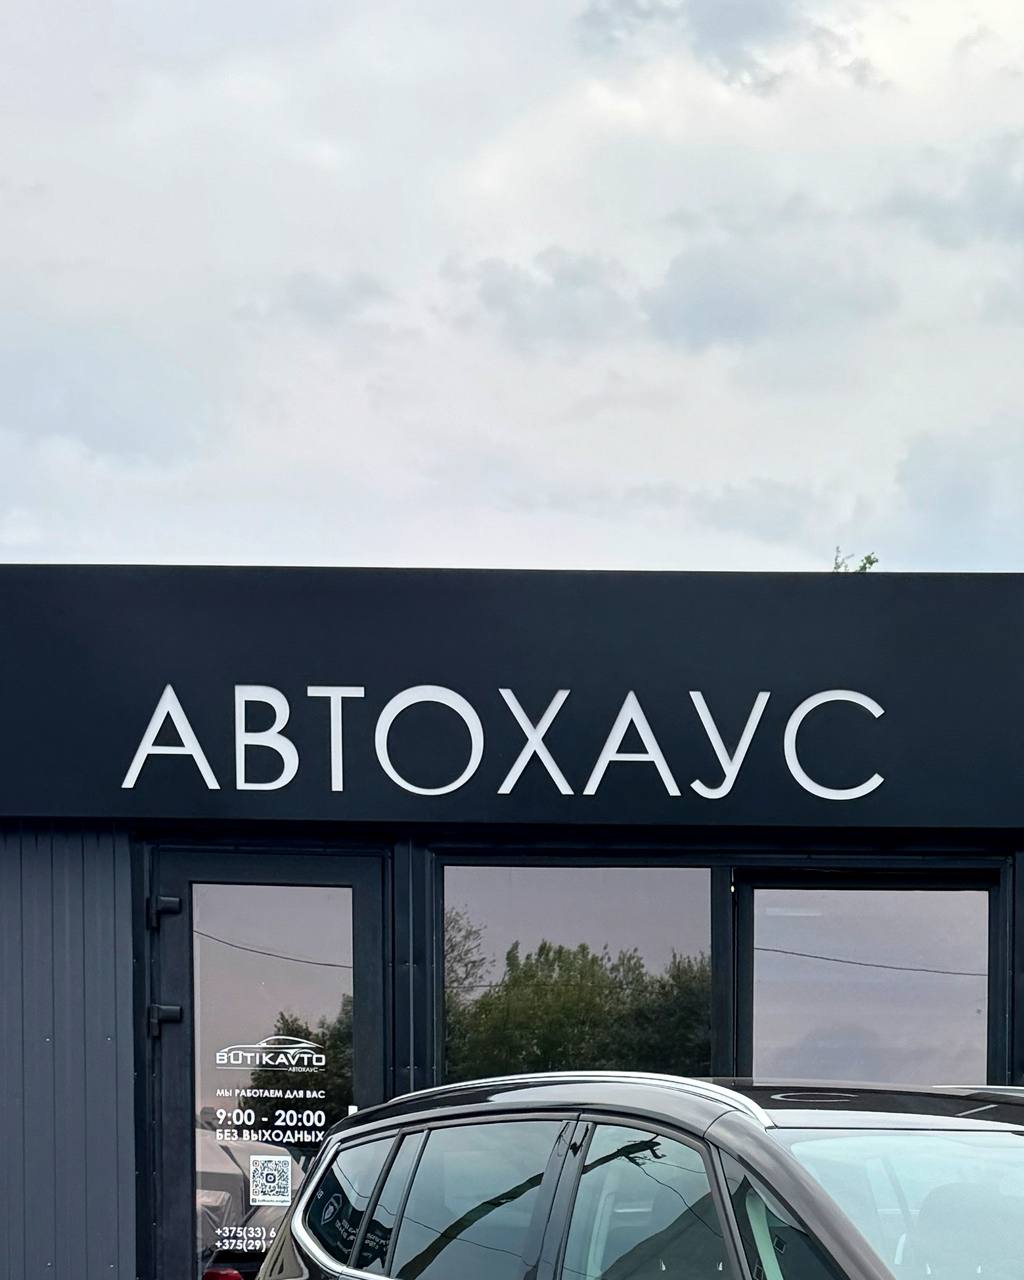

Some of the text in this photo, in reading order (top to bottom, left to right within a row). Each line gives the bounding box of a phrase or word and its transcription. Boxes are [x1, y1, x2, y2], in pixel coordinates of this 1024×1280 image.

[121, 683, 886, 801] АВТОХАУС
[215, 1050, 326, 1066] BUTIKAVTO
[215, 1088, 326, 1099] МЫ РАБОТАЕМ ДЛЯ ВАС
[215, 1108, 256, 1126] 9:00
[274, 1109, 326, 1127] 20:00
[215, 1128, 325, 1143] БЕЗ ВЫХОДНЫХ
[215, 1226, 266, 1240] +375(33)
[215, 1239, 266, 1253] +375(29)
